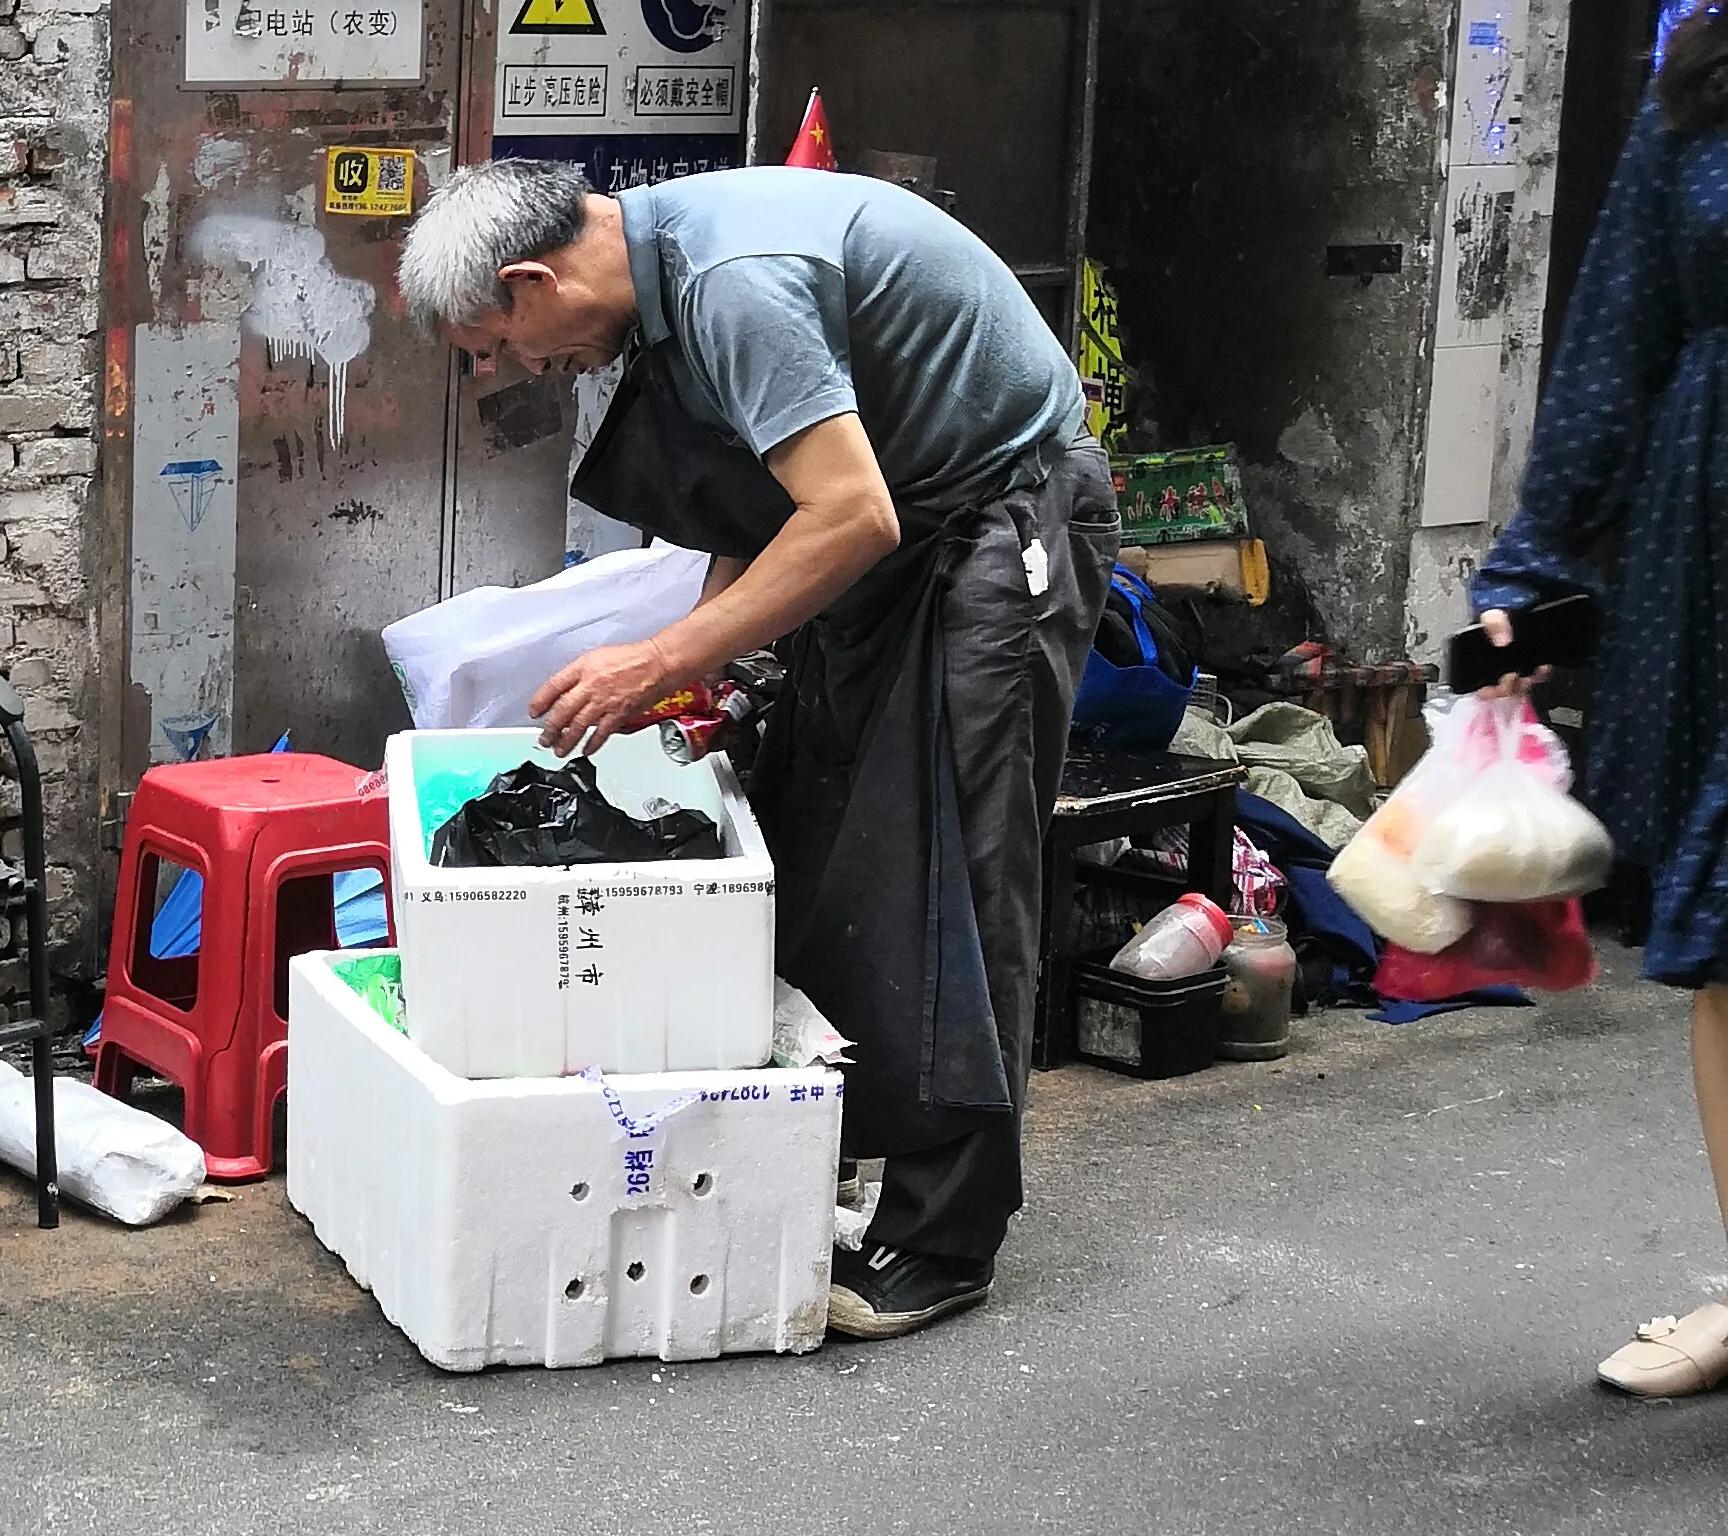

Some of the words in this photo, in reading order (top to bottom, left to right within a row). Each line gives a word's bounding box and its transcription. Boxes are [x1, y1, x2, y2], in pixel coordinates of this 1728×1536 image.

[543, 75, 602, 107] 高压危险
[639, 77, 730, 108] 必须戴安全帽
[338, 159, 364, 186] 收
